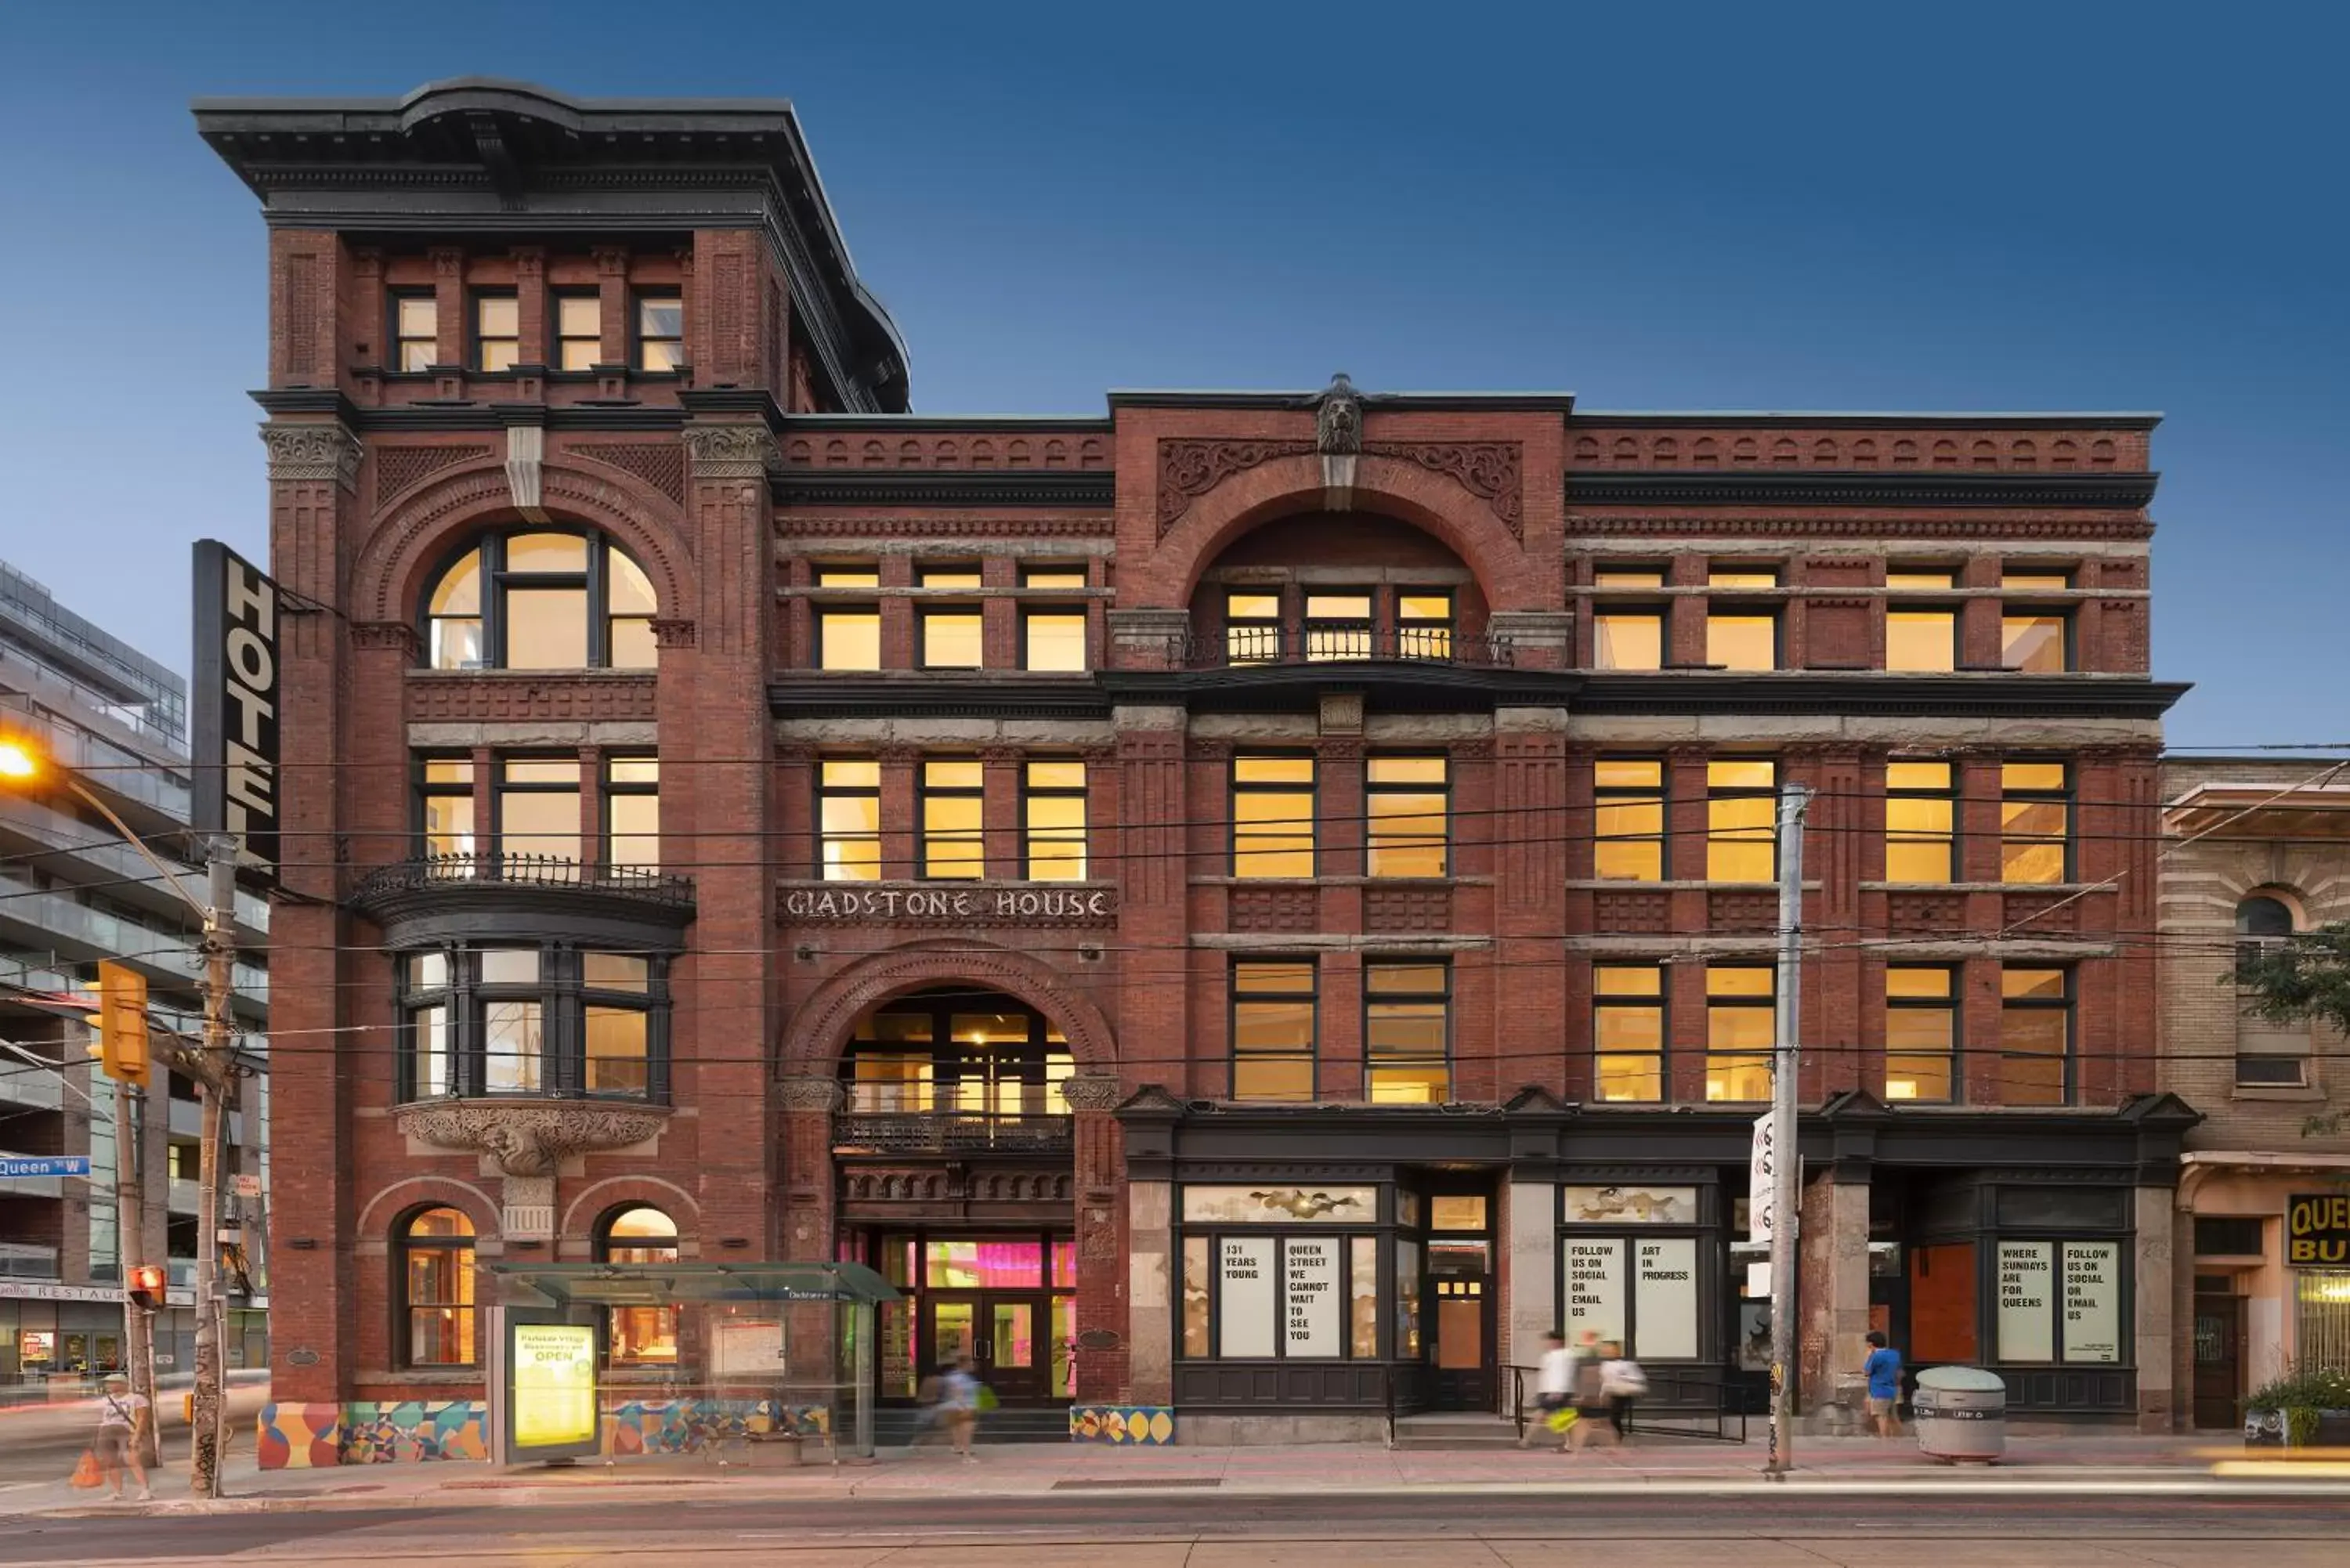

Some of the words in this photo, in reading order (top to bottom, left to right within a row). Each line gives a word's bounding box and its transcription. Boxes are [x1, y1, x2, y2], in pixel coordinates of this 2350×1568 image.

[226, 557, 273, 876] HOTEL
[996, 891, 1107, 916] HOUSE
[0, 1161, 49, 1175] Queen
[66, 1158, 79, 1172] W
[2292, 1198, 2350, 1235] QUE
[1226, 1245, 1242, 1254] 131
[1289, 1245, 1321, 1255] QUEEN
[1571, 1246, 1613, 1255] FOLLOW
[1642, 1246, 1661, 1255] ART
[2002, 1249, 2037, 1259] WHERE
[2067, 1249, 2110, 1259] FOLLOW
[1225, 1257, 1257, 1266] YEARS
[1289, 1257, 1327, 1266] STREET
[1571, 1259, 1585, 1268] US
[1588, 1259, 1602, 1268] ON
[1642, 1259, 1653, 1268] IN
[2002, 1262, 2048, 1271] SUNDAYS
[2067, 1262, 2081, 1271] US
[2084, 1262, 2098, 1271] ON
[1225, 1270, 1259, 1279] YOUNG
[1289, 1270, 1306, 1279] WE
[1571, 1270, 1607, 1280] SOCIAL
[1642, 1271, 1688, 1281] PROGRESS
[2002, 1274, 2021, 1283] ARE
[2067, 1274, 2104, 1284] SOCIAL
[1289, 1282, 1329, 1292] CANNOT
[1571, 1283, 1585, 1292] OR
[2002, 1285, 2022, 1295] FOR
[2067, 1286, 2081, 1296] OR
[38, 1286, 125, 1300] RESTAUR
[1290, 1295, 1314, 1304] WAIT
[1571, 1295, 1602, 1304] EMAIL
[2002, 1298, 2041, 1308] QUEENS
[2067, 1299, 2098, 1308] EMAIL
[1290, 1306, 1303, 1316] TO
[1571, 1307, 1585, 1317] US
[2067, 1310, 2081, 1320] US
[1290, 1319, 1309, 1328] SEE
[1290, 1331, 1310, 1340] YOU
[535, 1351, 573, 1362] OPEN
